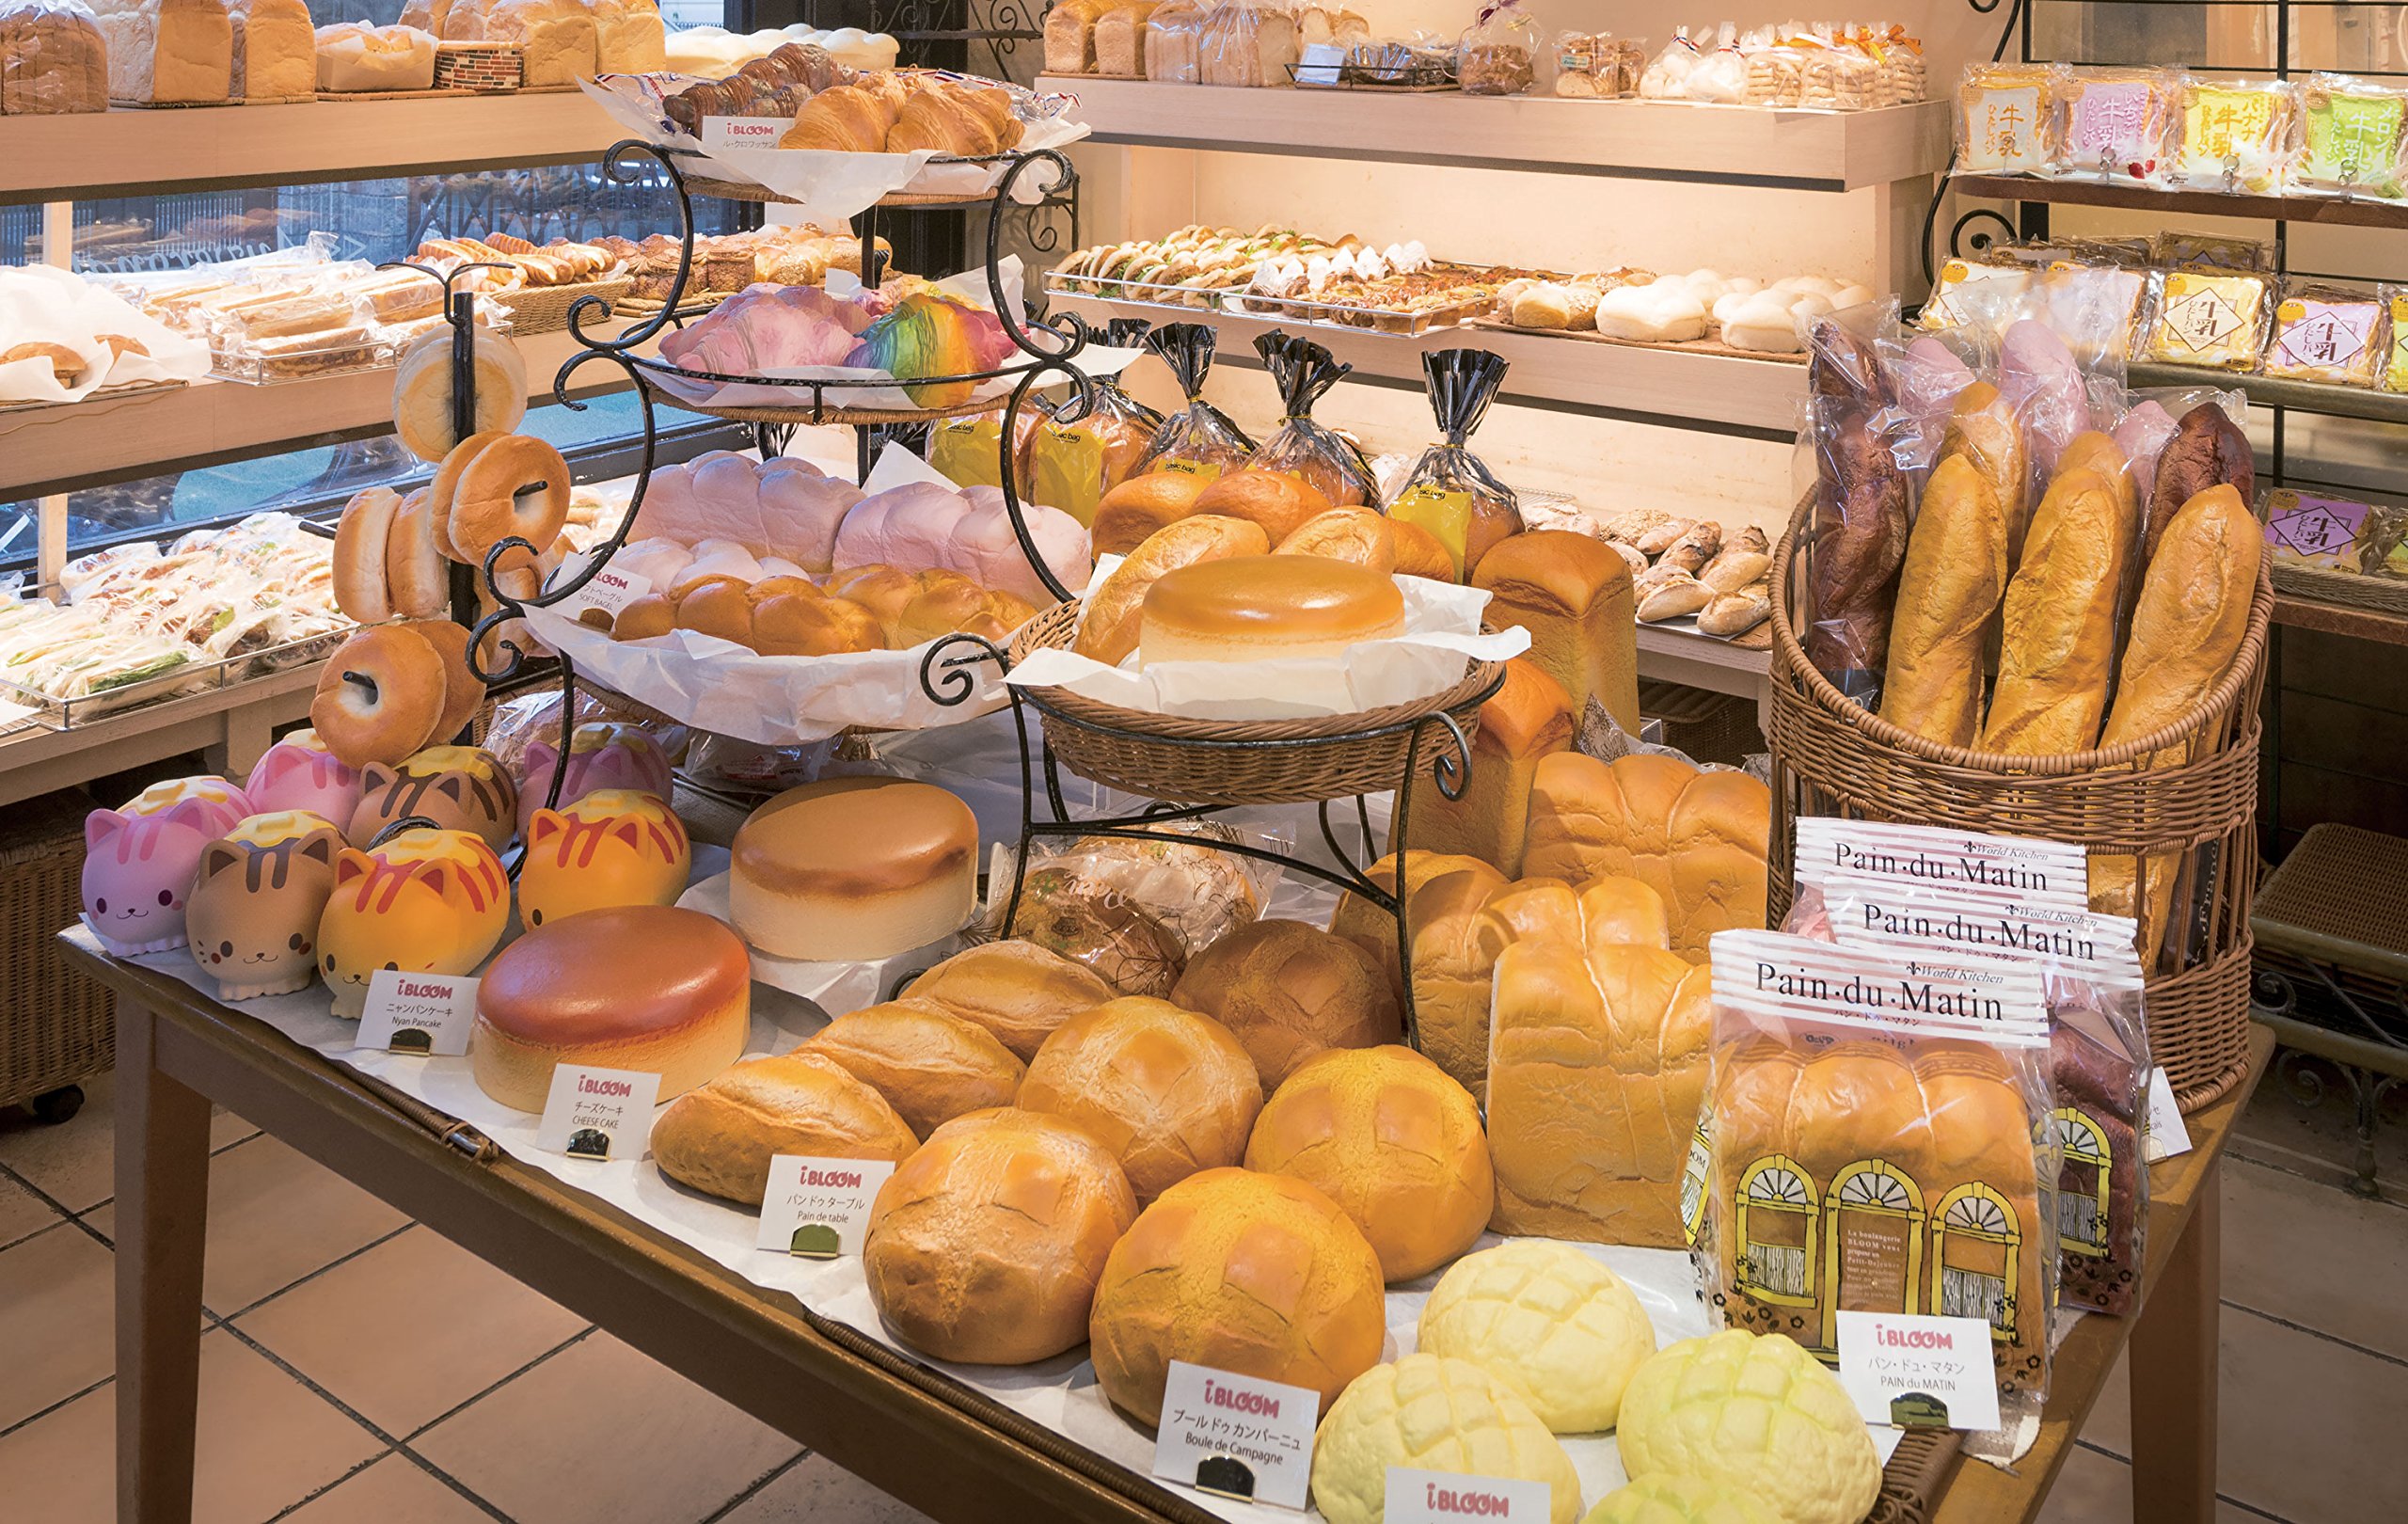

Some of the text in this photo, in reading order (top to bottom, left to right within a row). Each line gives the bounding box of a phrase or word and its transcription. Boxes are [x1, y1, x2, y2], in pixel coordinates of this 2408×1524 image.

[2374, 106, 2392, 150] メロン
[584, 584, 623, 603] フトベーグル
[1976, 844, 2049, 861] World Kitchen
[2020, 907, 2054, 920] World
[1921, 964, 2004, 985] World Kitchen
[391, 1016, 442, 1028] Nyan Pancake
[575, 1101, 624, 1117] チーズケーキ
[572, 1115, 620, 1129] CHEESE CAKE
[798, 1210, 849, 1224] Pain de table
[1847, 1237, 1879, 1249] BLOOM
[1881, 1375, 1956, 1391] PAIN du MATIN
[1185, 1431, 1284, 1466] Boule de Campagne
